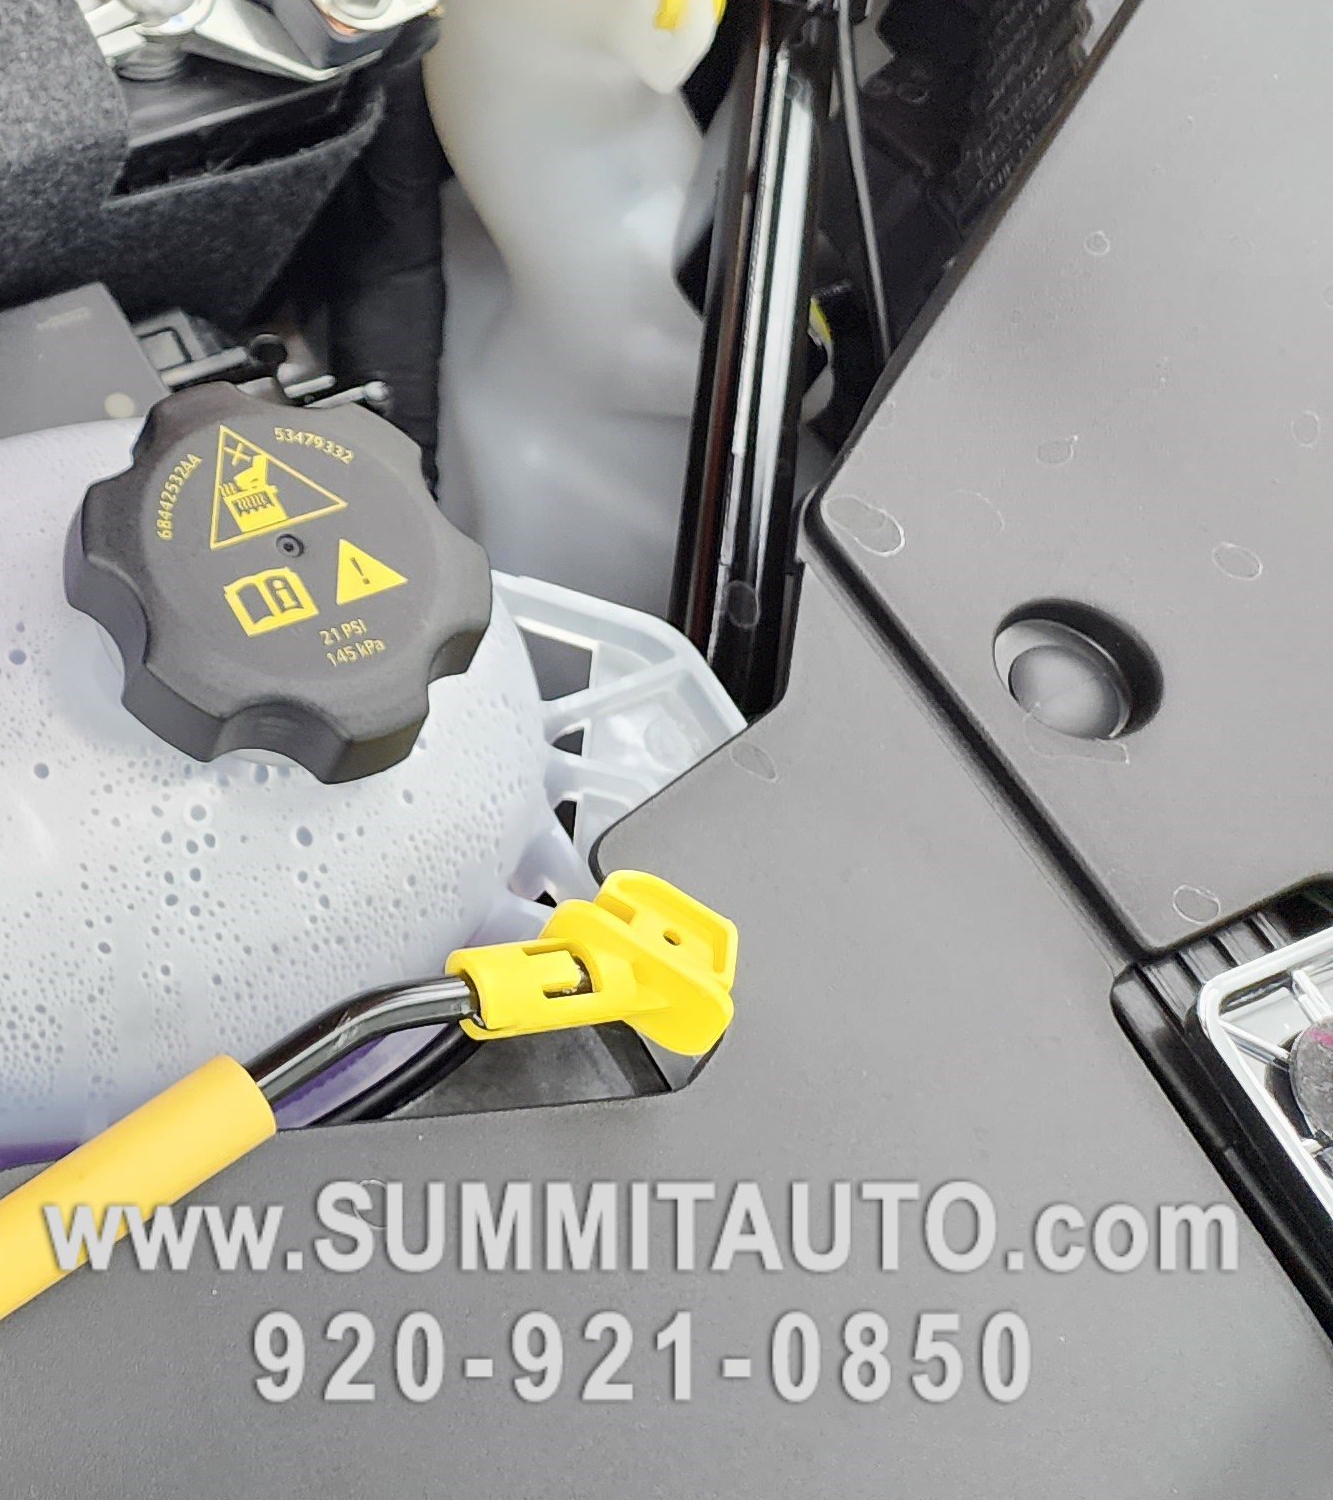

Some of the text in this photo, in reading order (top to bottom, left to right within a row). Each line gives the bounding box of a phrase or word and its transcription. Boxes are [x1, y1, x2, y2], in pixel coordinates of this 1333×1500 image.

[274, 426, 355, 465] 53479332
[319, 618, 368, 647] 21 PSI
[327, 638, 386, 668] 145 kPa
